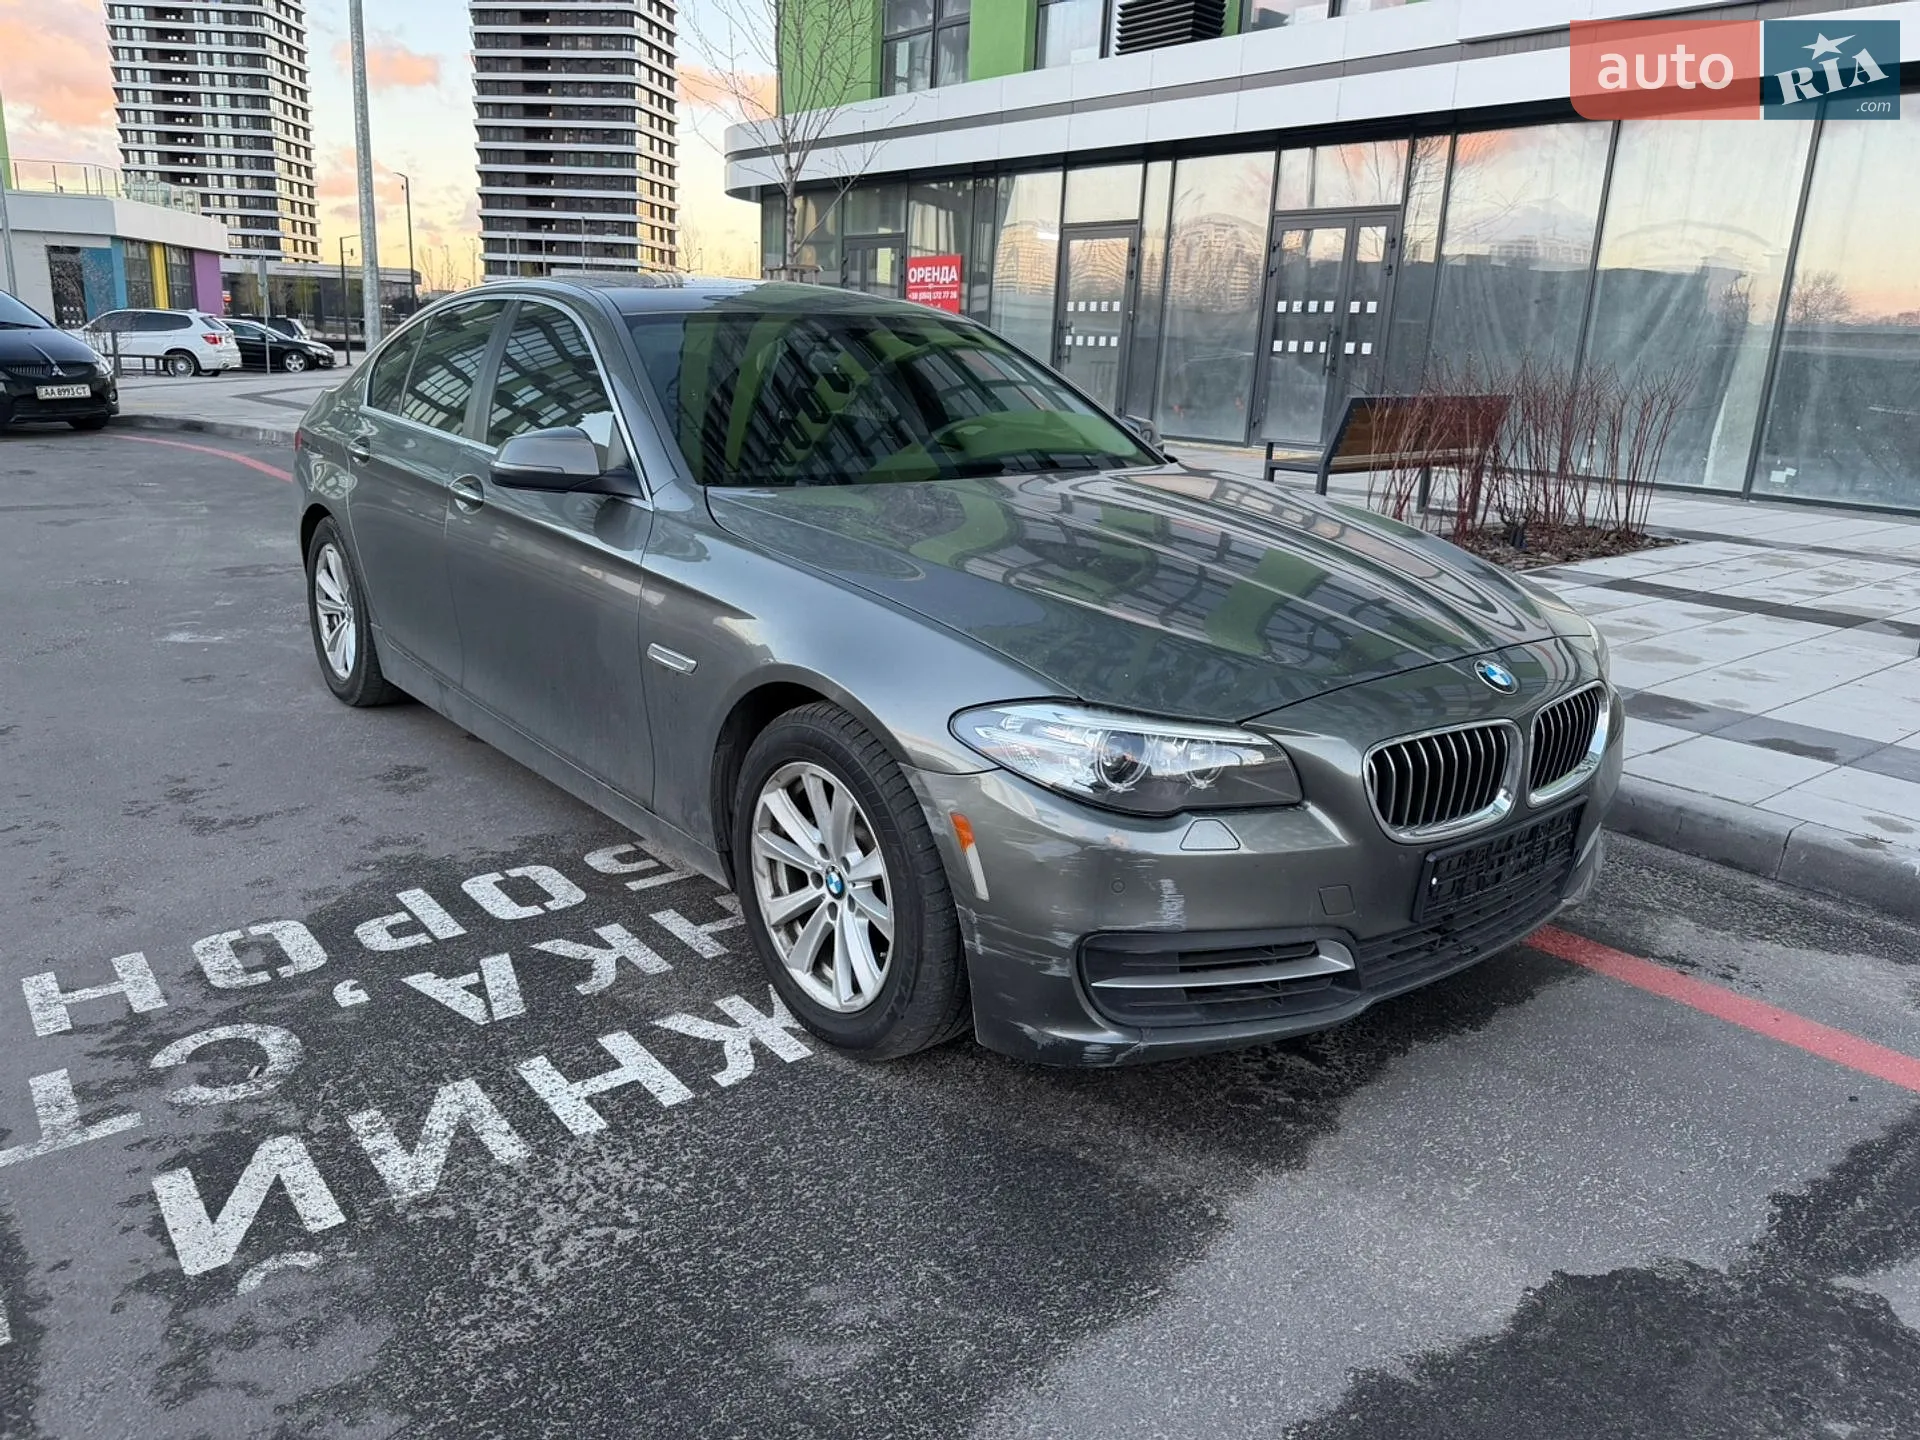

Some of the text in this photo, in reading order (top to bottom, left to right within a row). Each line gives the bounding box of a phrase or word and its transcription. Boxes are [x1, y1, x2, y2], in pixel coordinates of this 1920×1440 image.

[908, 265, 958, 284] ОРЕНДА
[45, 388, 56, 397] AA
[76, 386, 86, 395] CT
